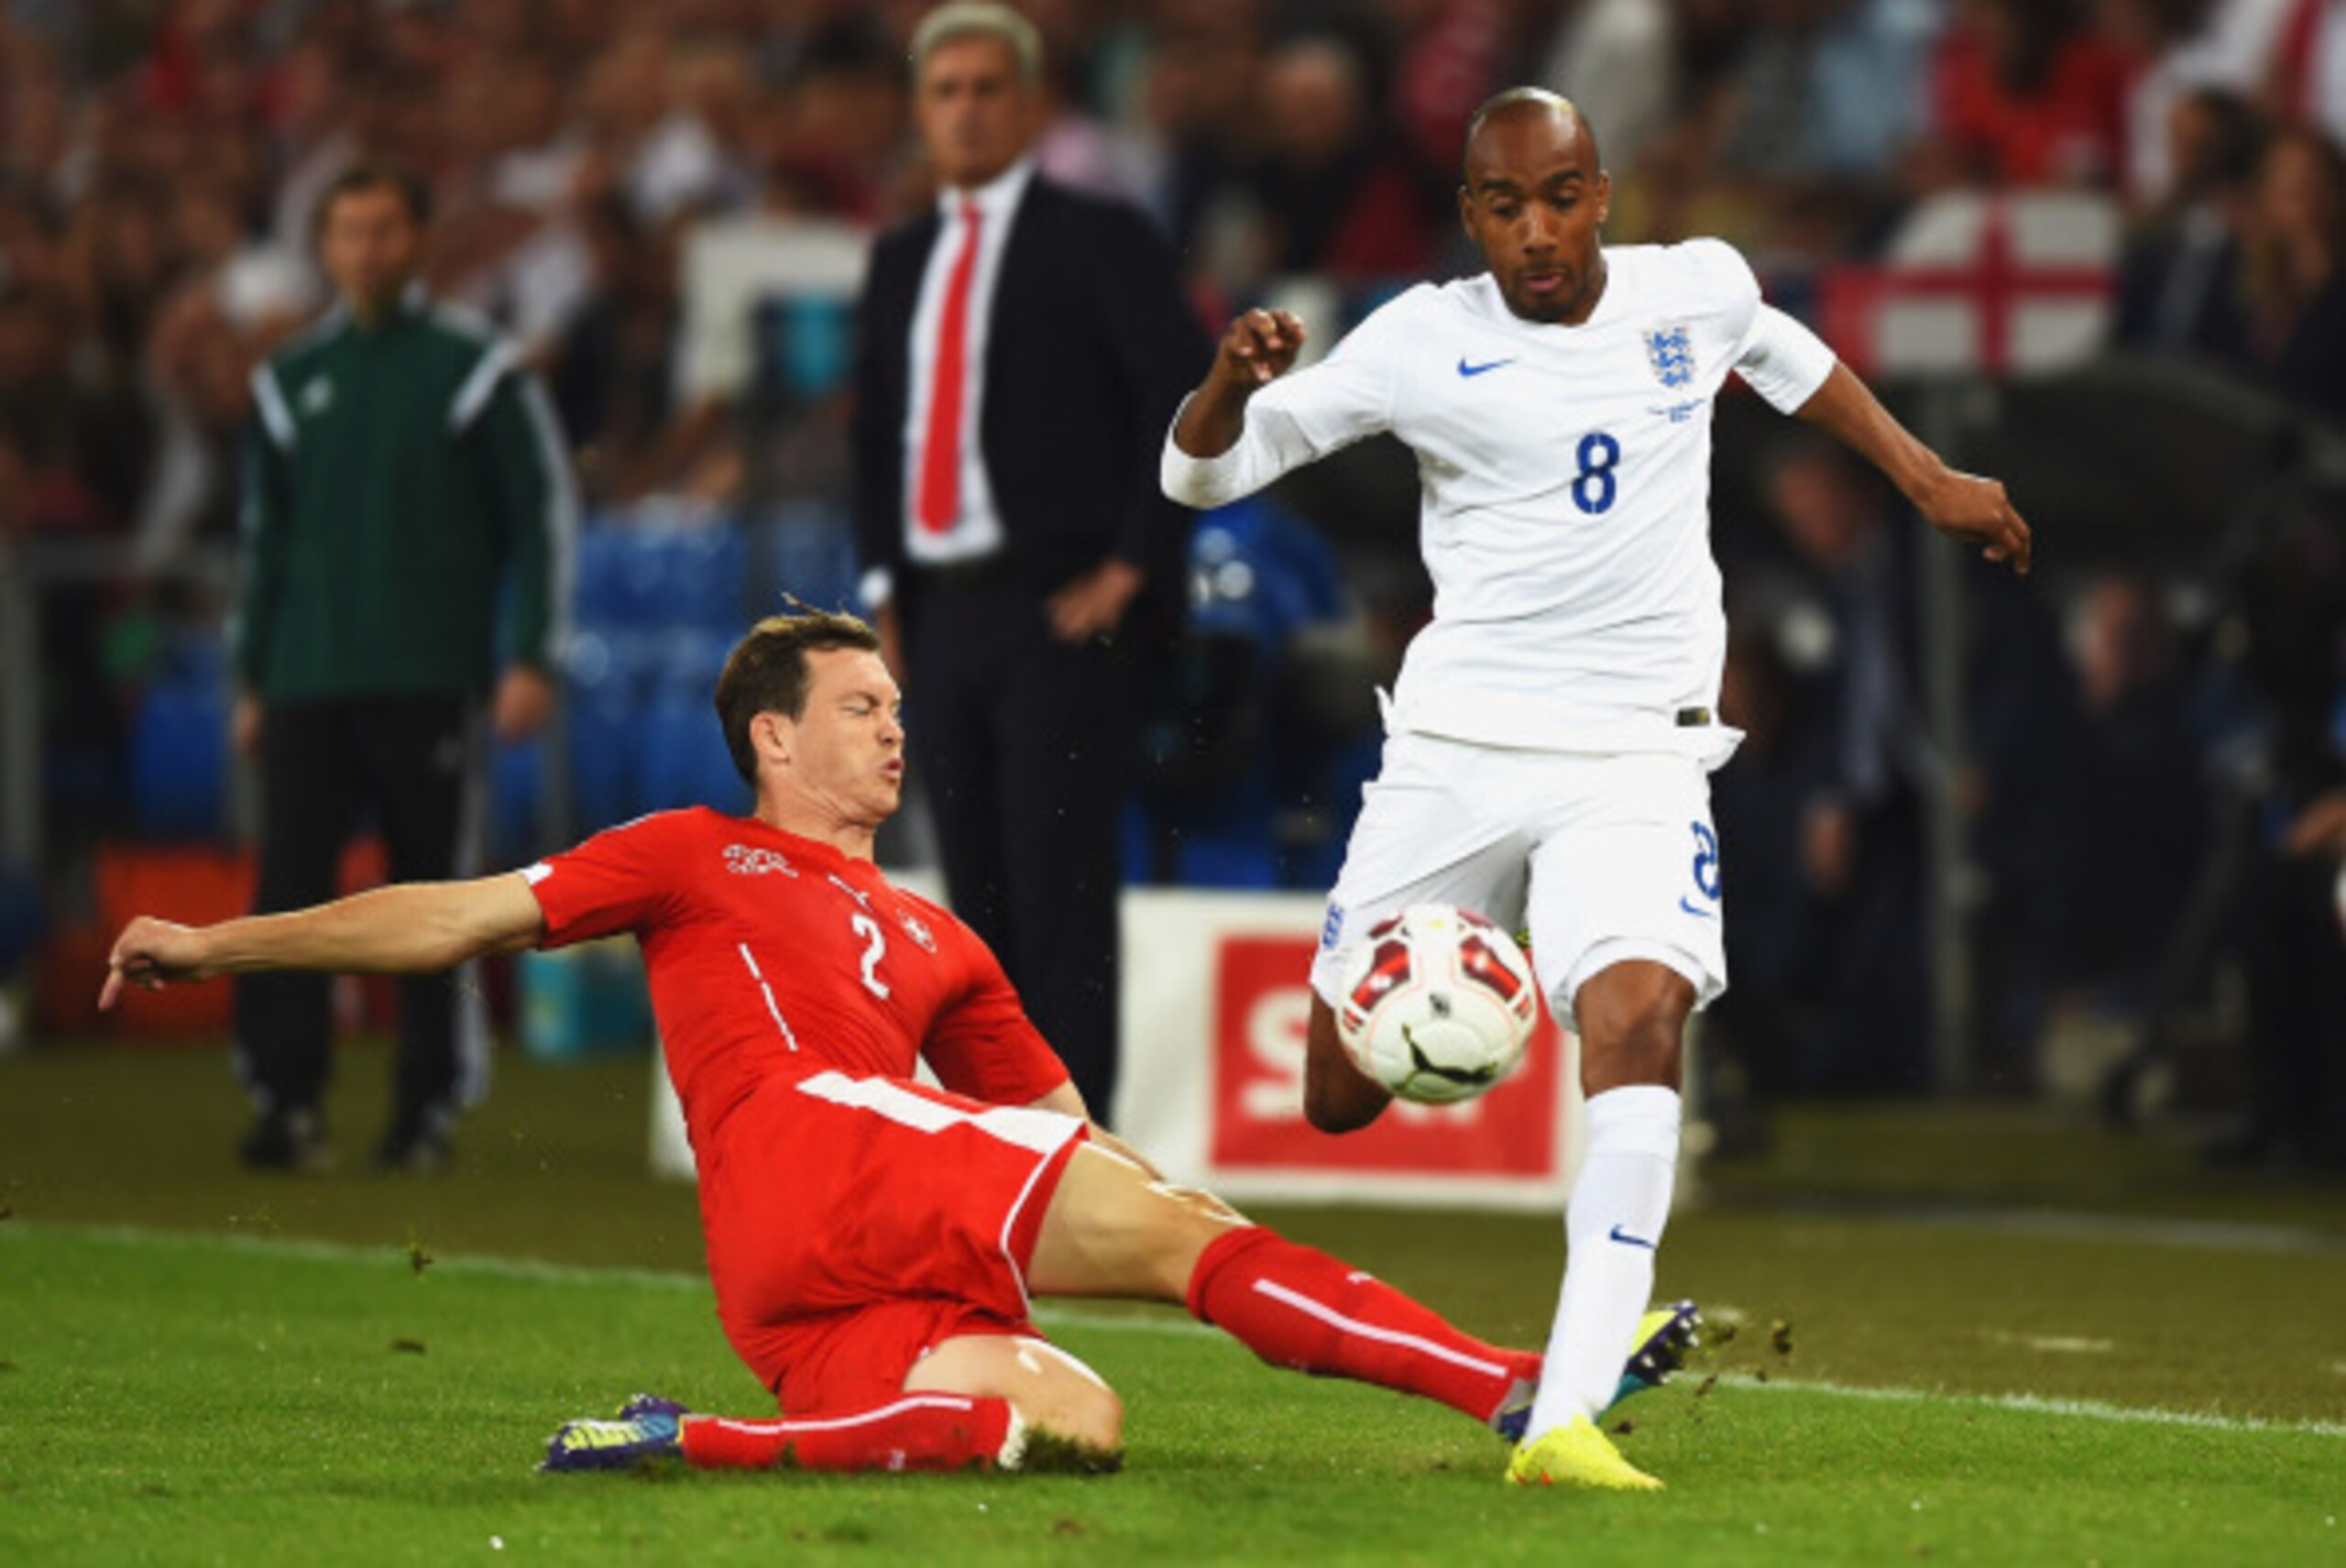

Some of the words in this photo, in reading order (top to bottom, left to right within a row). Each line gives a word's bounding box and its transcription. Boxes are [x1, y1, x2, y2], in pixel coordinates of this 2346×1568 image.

[1572, 431, 1620, 514] 8
[1691, 821, 1722, 898] 8
[851, 913, 890, 1000] 2
